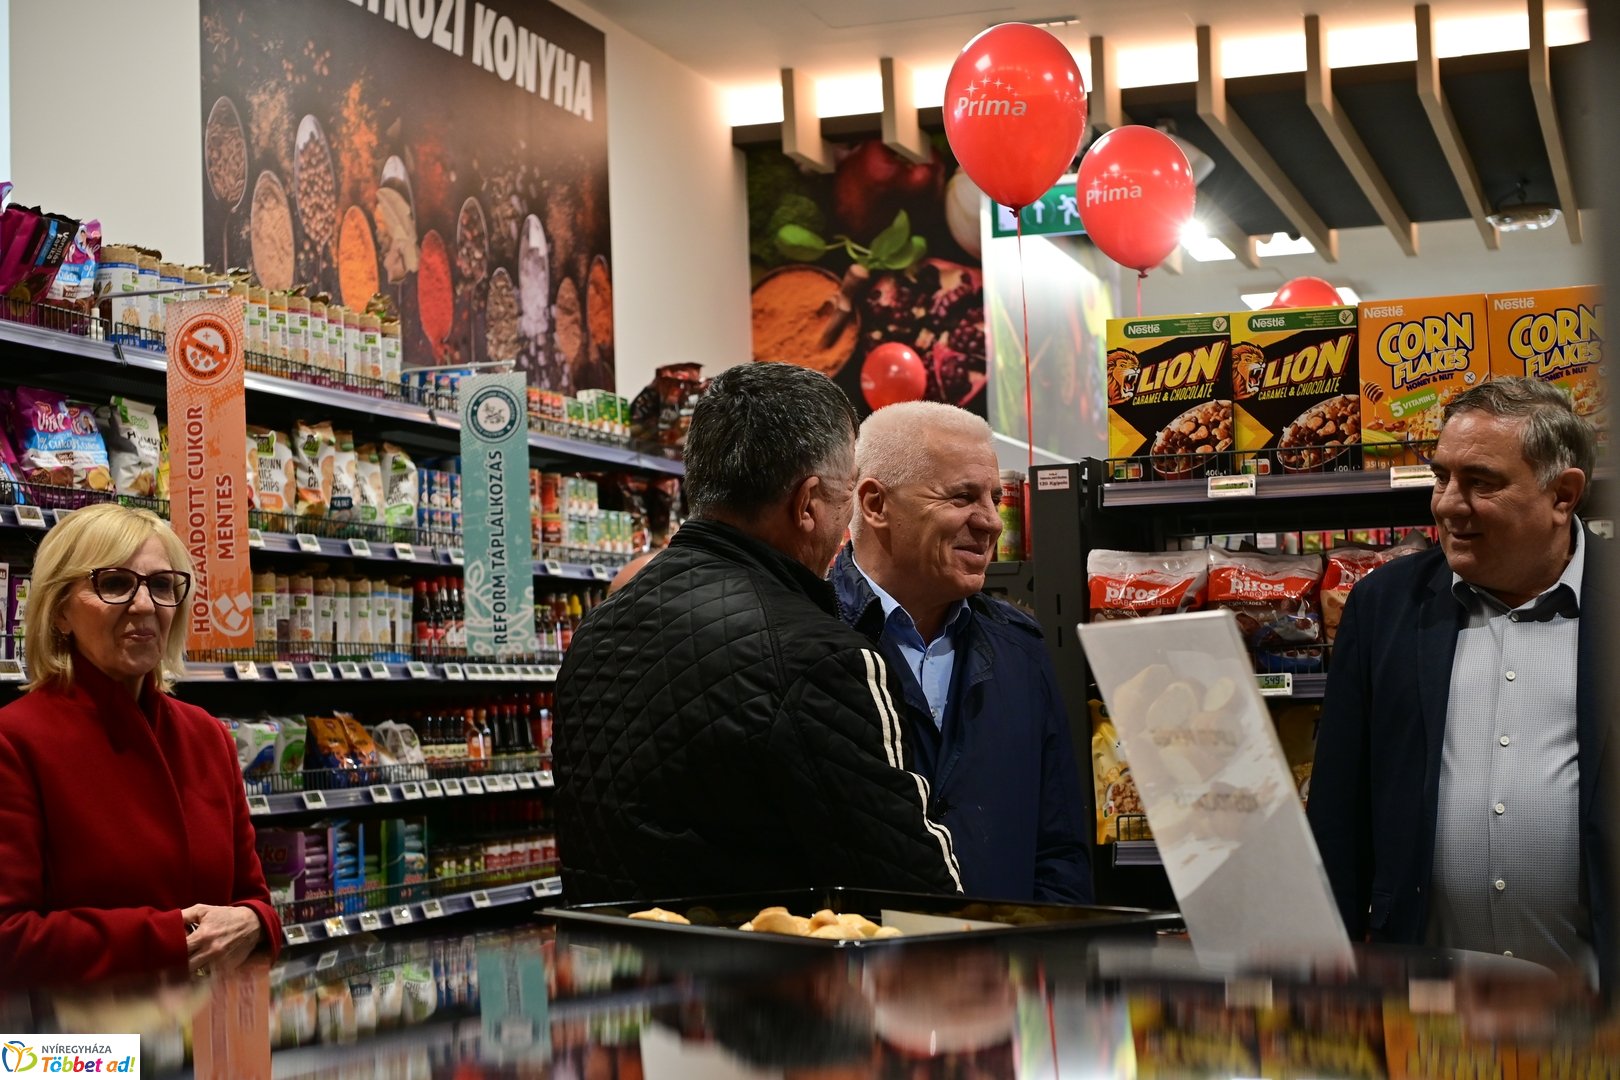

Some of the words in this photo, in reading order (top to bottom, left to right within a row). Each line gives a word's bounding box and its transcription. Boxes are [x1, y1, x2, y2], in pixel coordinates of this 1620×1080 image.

[472, 3, 593, 122] KONYHA
[1364, 305, 1405, 319] Nestlé
[1494, 297, 1536, 311] Nestlé
[1127, 323, 1161, 335] Nestlé
[1252, 316, 1285, 329] Nestlé
[1508, 304, 1606, 359] CORN
[1377, 312, 1474, 366] CORN
[1138, 340, 1227, 392] LION
[1264, 332, 1353, 389] LION
[1393, 347, 1470, 389] FLAKES
[1525, 340, 1602, 378] FLAKES
[1572, 365, 1588, 376] NUT
[1132, 391, 1162, 406] CARAMEL
[1162, 390, 1169, 402] &
[1169, 382, 1215, 402] CHOCOLATE
[1258, 386, 1288, 401] CARAMEL
[1288, 386, 1296, 397] &
[1296, 376, 1340, 397] CHOCOLATE
[1406, 377, 1431, 392] HONEY
[1438, 372, 1455, 382] NUT
[1390, 401, 1404, 418] 5
[1403, 393, 1437, 410] VITAMINS
[187, 405, 204, 480] CUKOR
[216, 474, 234, 559] MENTES
[486, 450, 506, 571] TÁPLÁLKOZÁS
[1104, 586, 1160, 603] piros
[1230, 576, 1285, 594] piros
[491, 574, 508, 645] REFORM
[1264, 675, 1280, 686] 549
